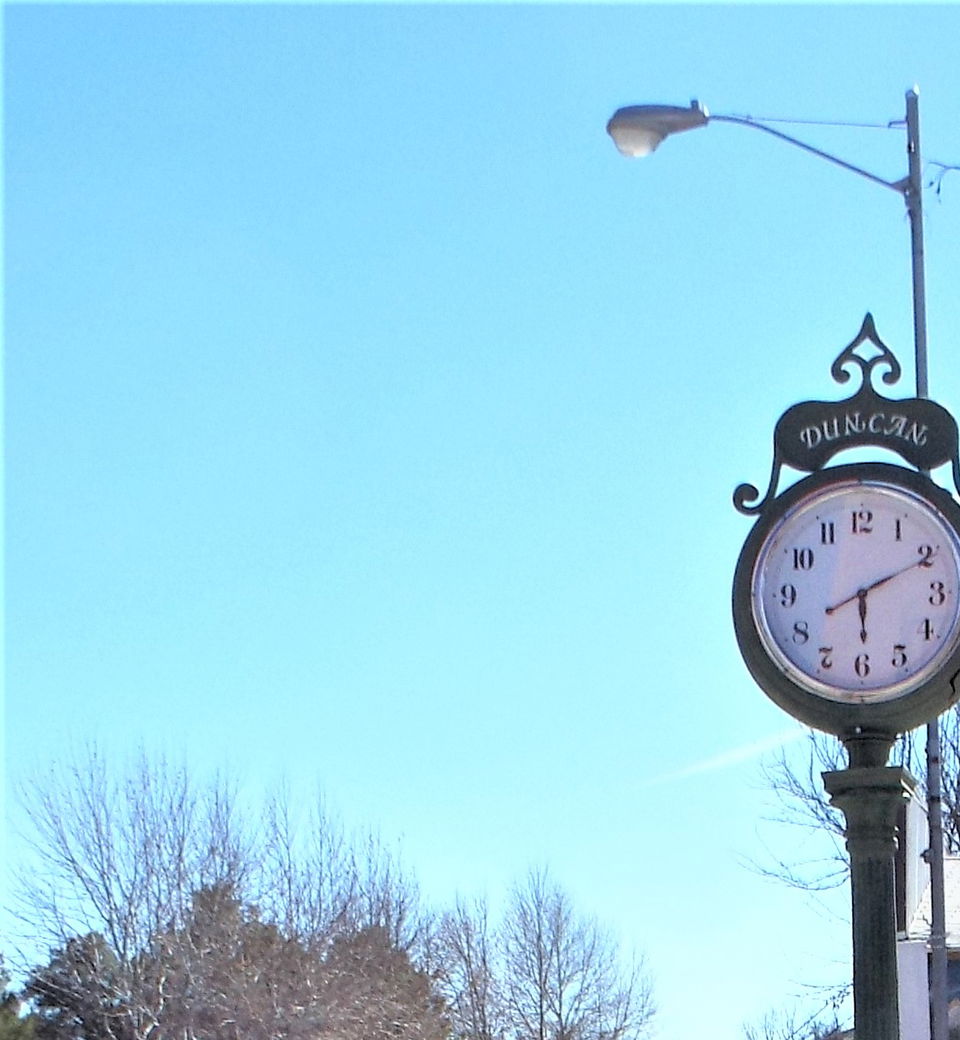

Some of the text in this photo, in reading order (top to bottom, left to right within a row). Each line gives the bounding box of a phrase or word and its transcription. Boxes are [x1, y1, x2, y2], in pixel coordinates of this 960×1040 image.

[800, 412, 928, 449] DUNCAN
[819, 522, 835, 544] 11
[851, 510, 874, 535] 12
[894, 519, 902, 542] 1
[792, 548, 815, 571] 10
[918, 545, 934, 568] 2
[780, 584, 797, 608] 9
[929, 581, 946, 606] 3
[793, 621, 809, 644] 8
[917, 617, 935, 640] 4
[818, 646, 834, 669] 7
[854, 654, 870, 677] 6
[892, 645, 907, 668] 5
